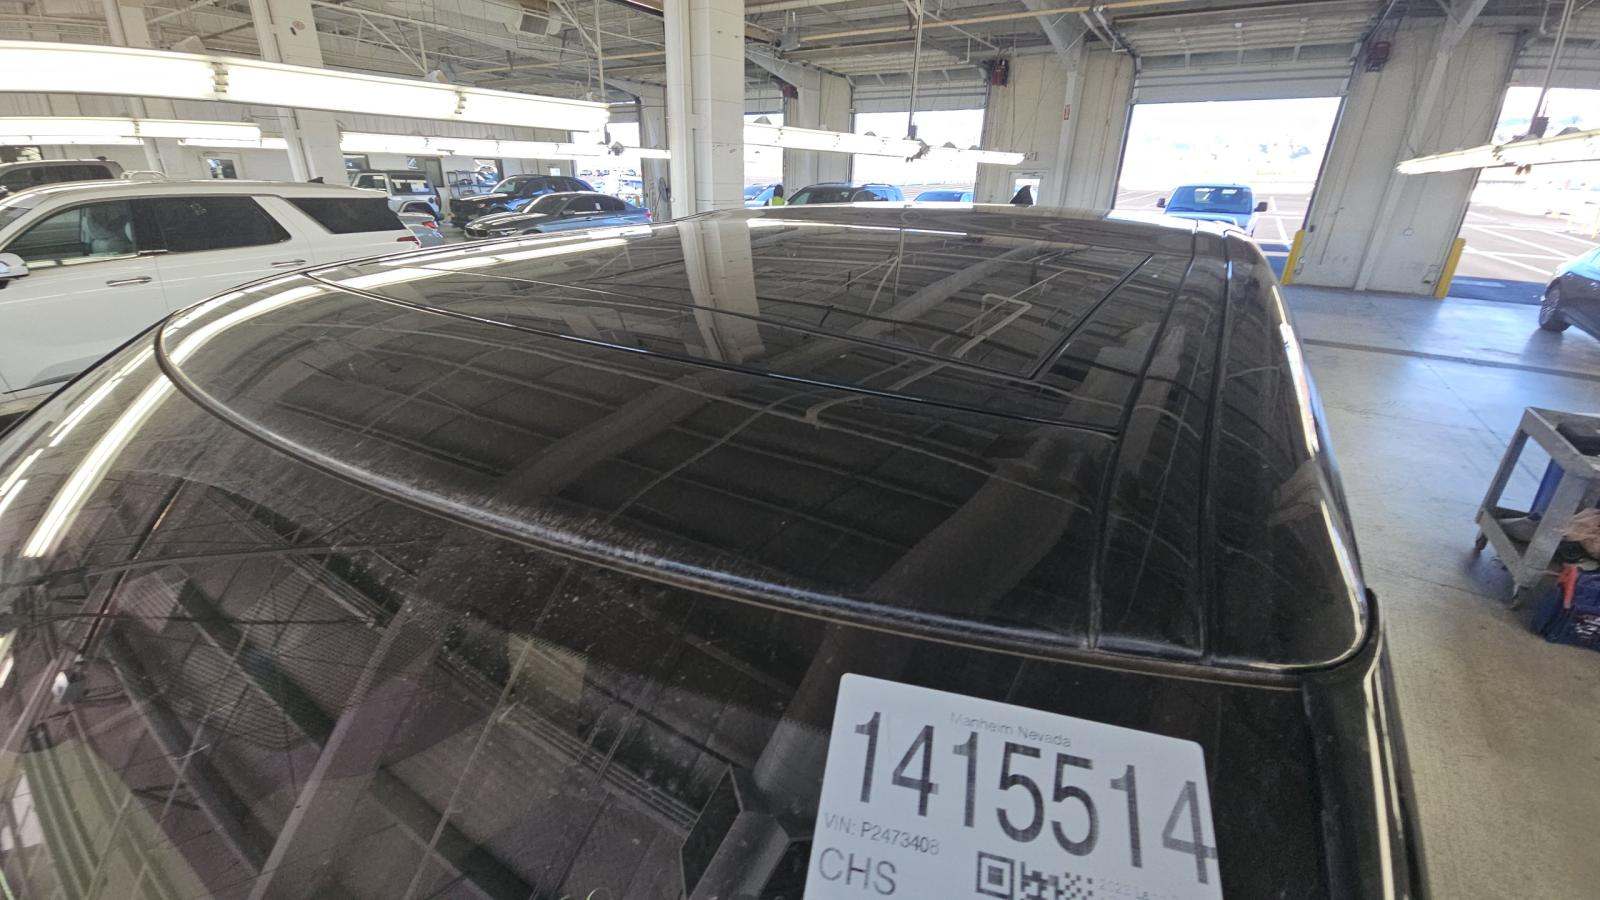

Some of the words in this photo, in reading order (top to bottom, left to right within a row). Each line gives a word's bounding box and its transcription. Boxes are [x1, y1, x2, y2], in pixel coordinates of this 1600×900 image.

[951, 712, 1013, 735] Manheim
[1017, 726, 1071, 748] Nevada
[854, 711, 1217, 884] 1415514
[824, 813, 856, 836] VIN:
[818, 847, 897, 896] CHS
